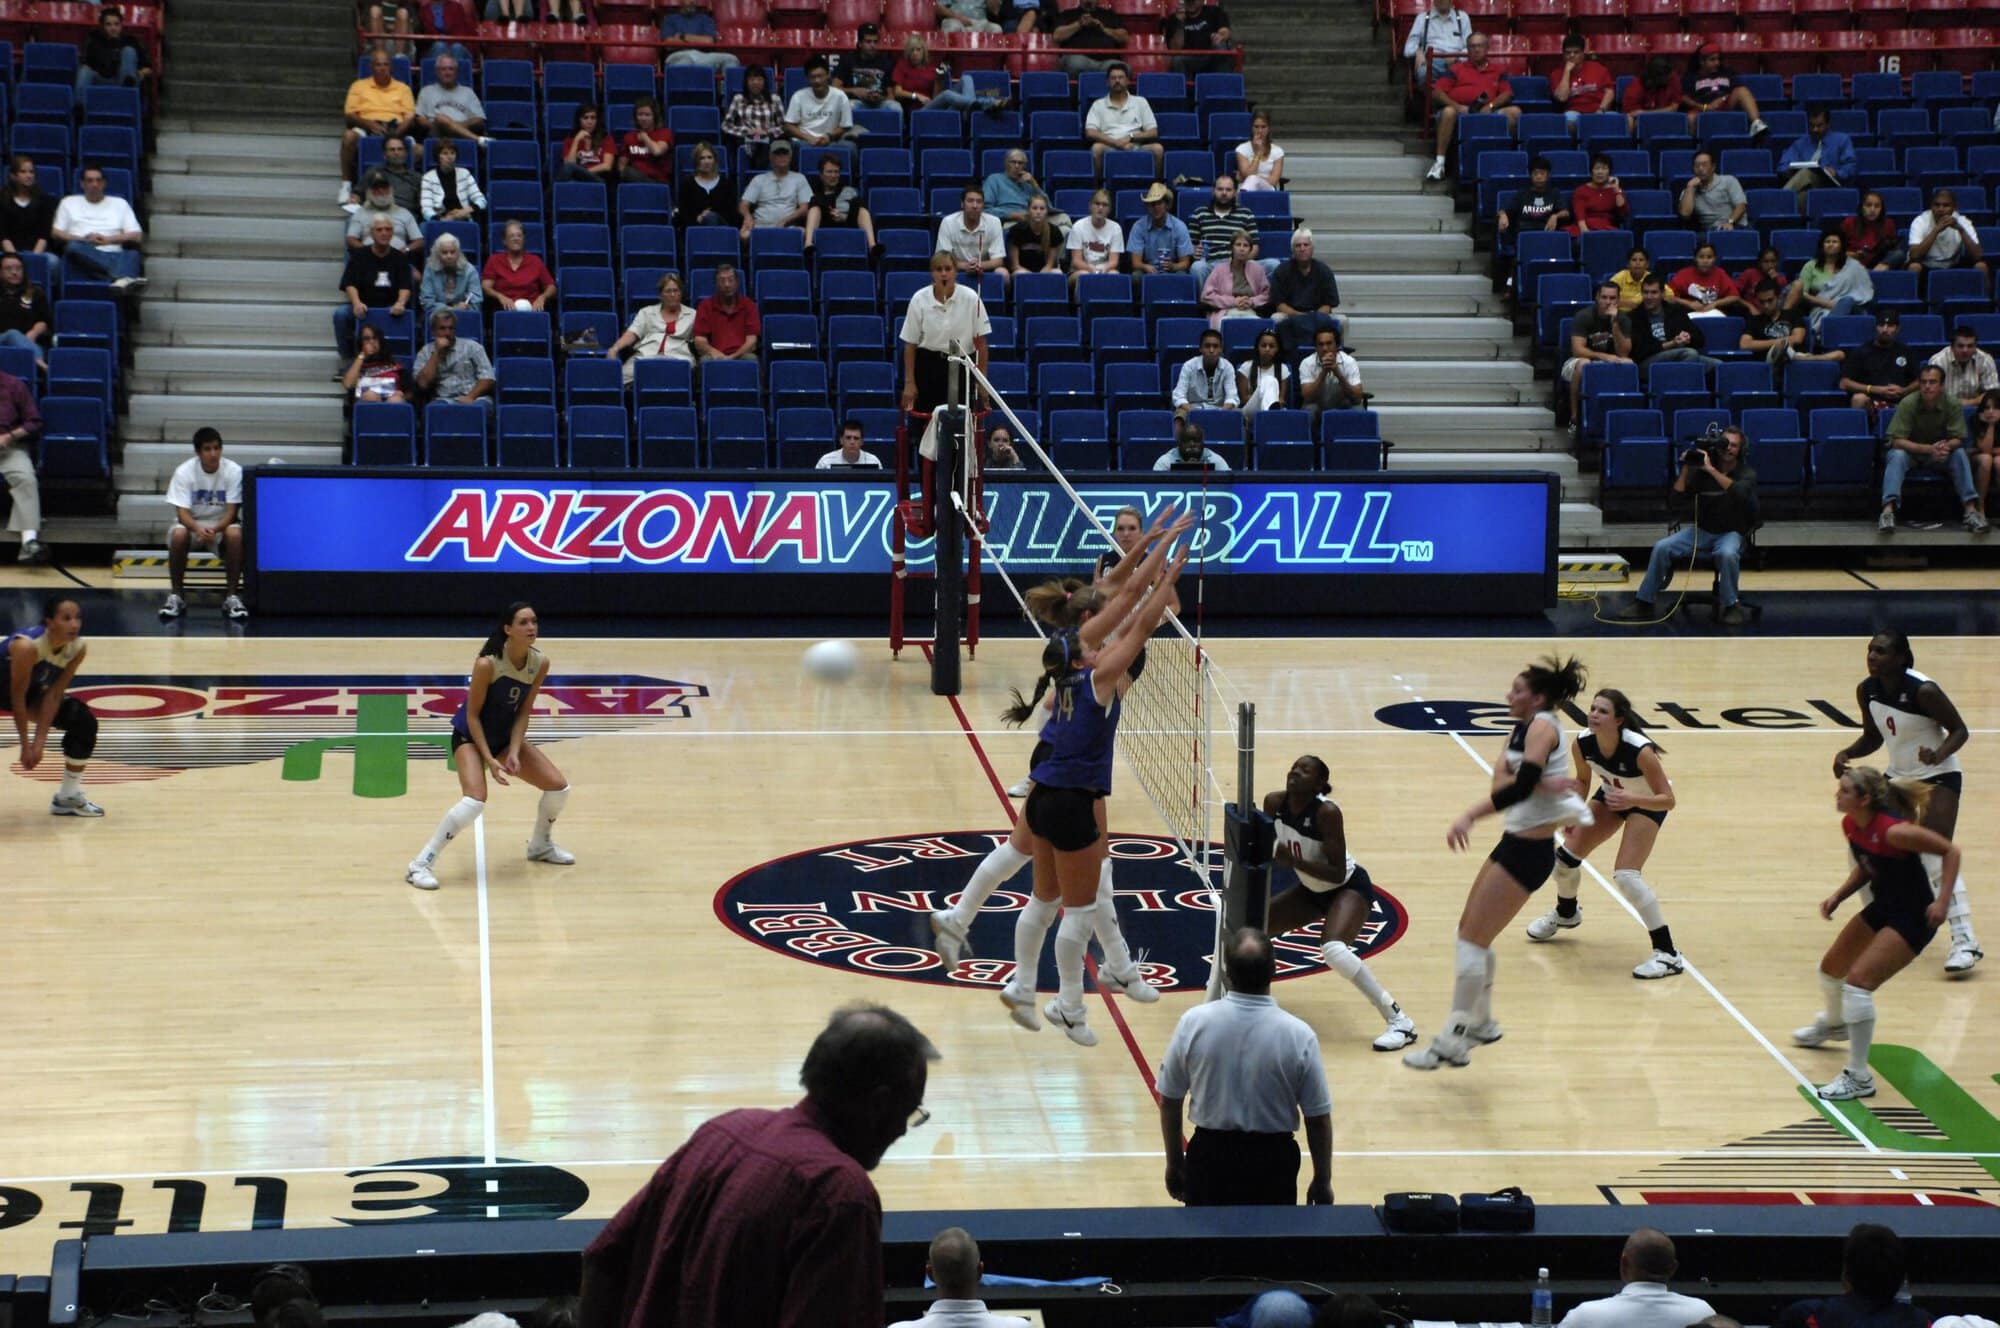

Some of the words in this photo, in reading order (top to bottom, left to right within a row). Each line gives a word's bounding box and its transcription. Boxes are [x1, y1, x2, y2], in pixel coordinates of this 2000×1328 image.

[1879, 56, 1900, 74] 16
[405, 489, 821, 563] ARIZONA
[1402, 540, 1434, 562] TM
[507, 686, 521, 704] 9
[1886, 716, 1896, 736] 9
